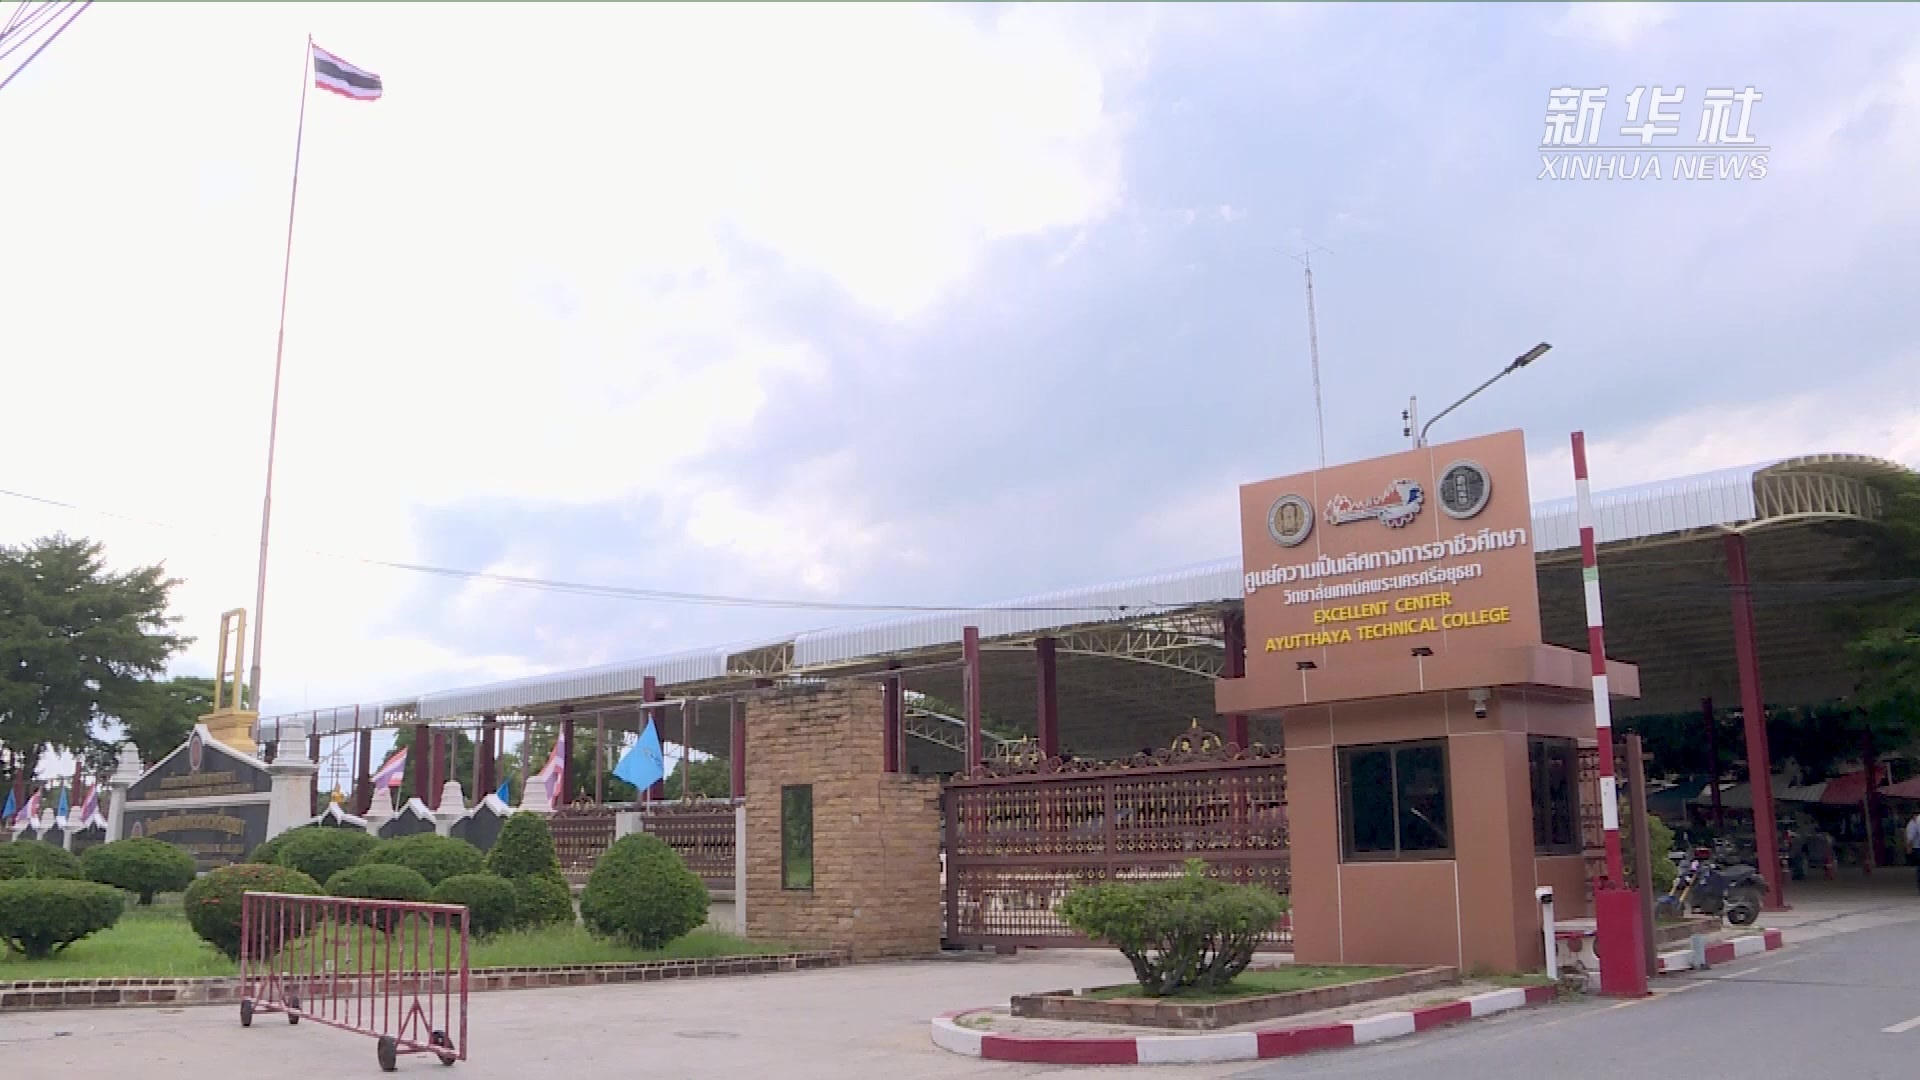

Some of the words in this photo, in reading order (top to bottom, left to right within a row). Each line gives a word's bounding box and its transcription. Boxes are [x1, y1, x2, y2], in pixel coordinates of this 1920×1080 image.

[1245, 528, 1527, 593] ศูนย์ความเป็นเลิศทางการอาชีวศึกษา
[1283, 563, 1482, 605] วิทยาลัยเทคนิคพระนครศรีอยุธยา
[1265, 629, 1352, 652] AYUTTHAYA
[1357, 617, 1438, 640] TECHNICAL
[1442, 606, 1510, 629] COLLEGE
[1313, 600, 1389, 624] EXCELLENT
[1395, 591, 1452, 612] CENTER
